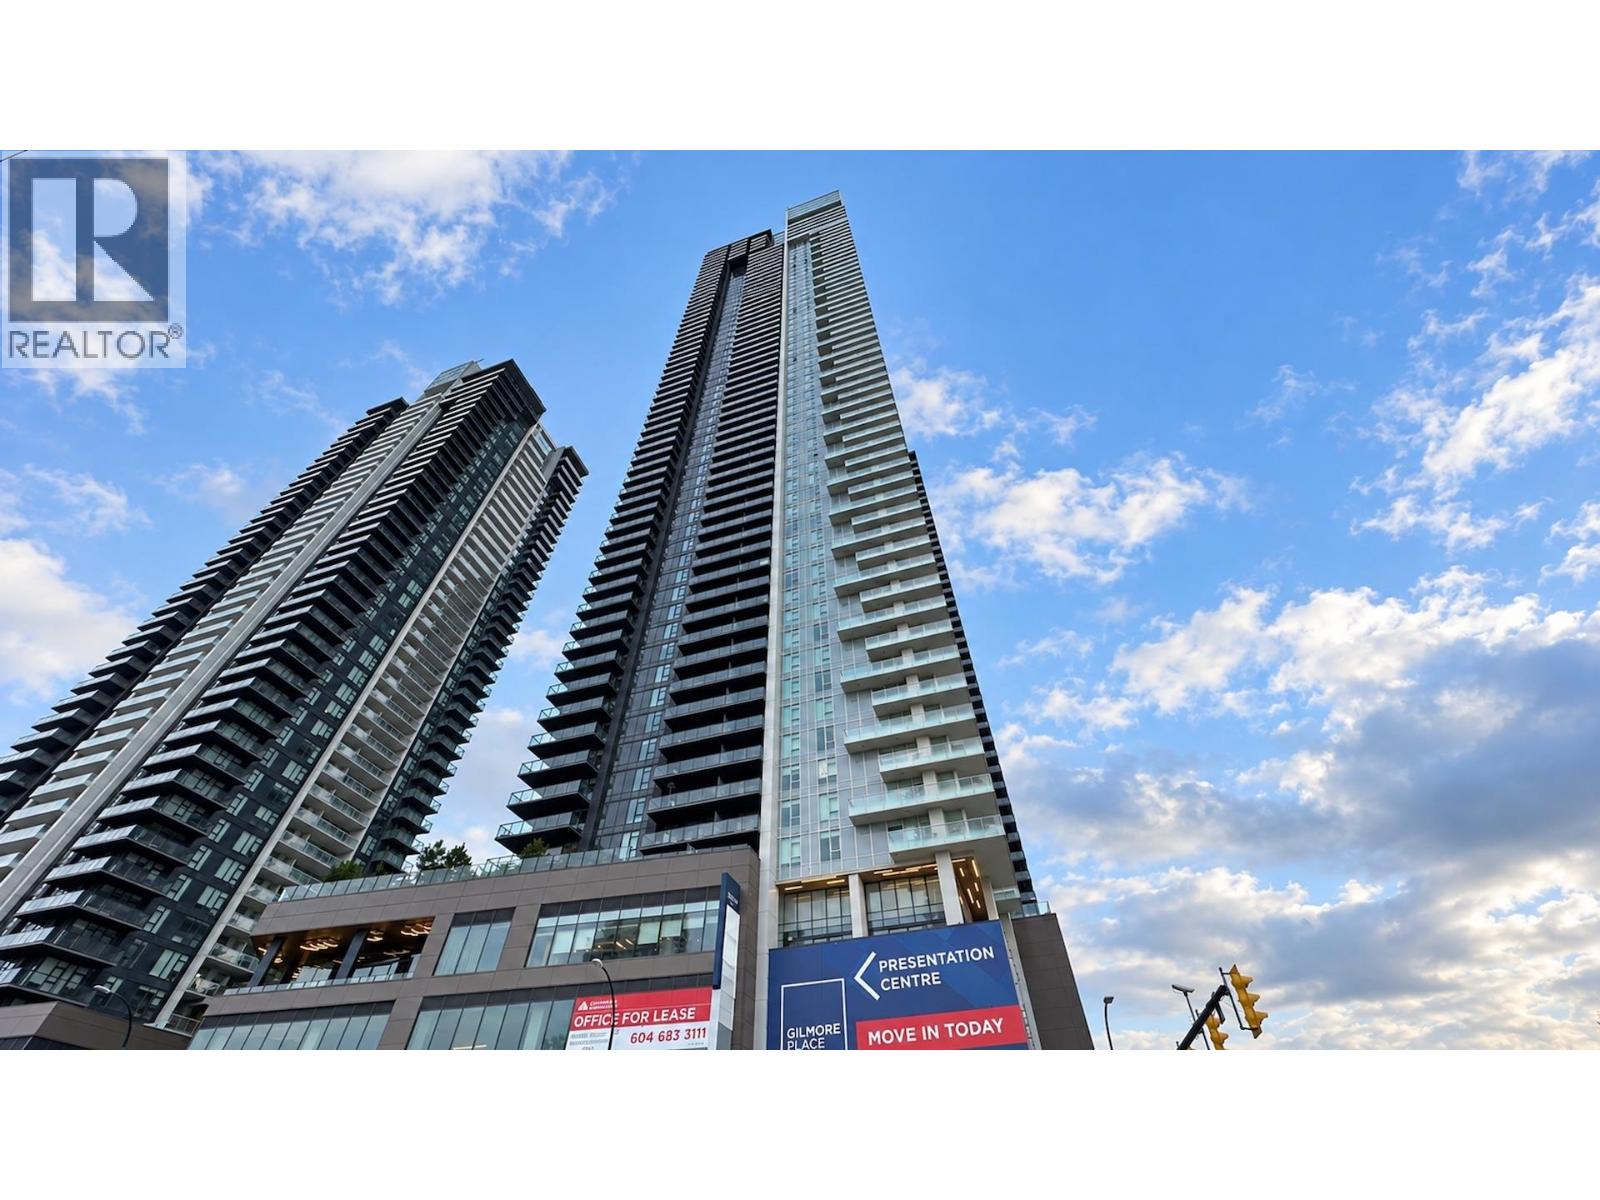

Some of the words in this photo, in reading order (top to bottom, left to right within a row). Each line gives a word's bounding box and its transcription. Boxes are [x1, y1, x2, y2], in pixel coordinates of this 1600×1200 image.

[879, 946, 995, 972] PRESENTATION
[880, 971, 942, 992] CENTRE
[574, 1012, 619, 1028] OFFICE
[621, 1010, 650, 1025] FOR
[653, 1007, 696, 1022] LEASE
[630, 1031, 654, 1045] 604
[658, 1029, 680, 1043] 683
[684, 1027, 707, 1040] 3111
[786, 1022, 841, 1039] GILMORE
[868, 1027, 917, 1046] MOVE
[922, 1024, 940, 1042] IN
[944, 1017, 1004, 1037] TODAY
[787, 1037, 826, 1050] PLACE
